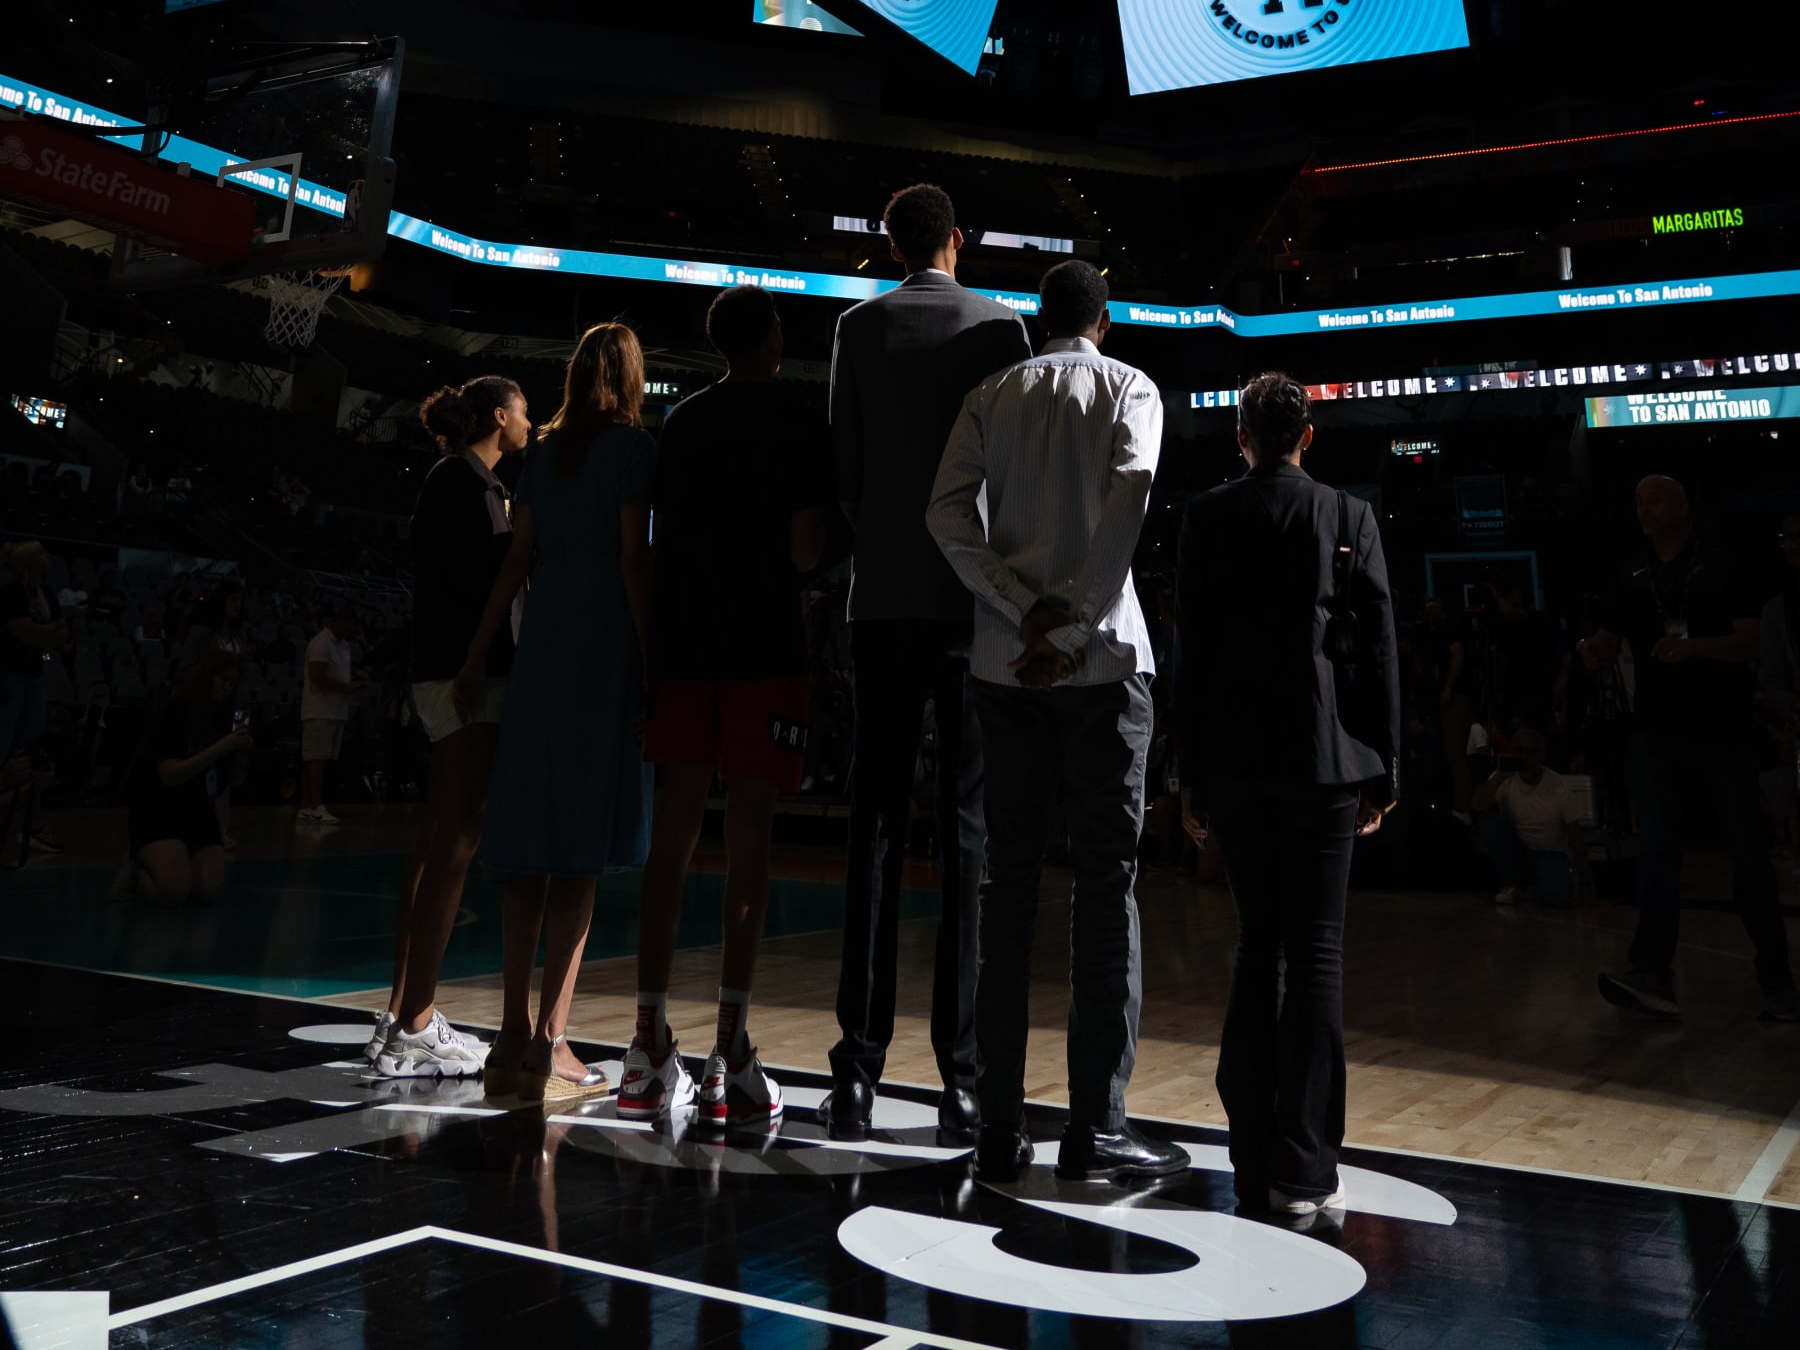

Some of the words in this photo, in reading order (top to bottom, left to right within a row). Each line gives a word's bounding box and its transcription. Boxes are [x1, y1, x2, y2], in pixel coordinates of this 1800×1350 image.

[1312, 10, 1339, 35] TO
[27, 90, 42, 111] To
[44, 98, 71, 121] San
[72, 107, 121, 127] Antoi
[312, 190, 346, 214] Antoni
[1652, 207, 1744, 234] MARGARITAS
[431, 230, 471, 255] Welcome
[472, 243, 485, 259] To
[487, 246, 510, 262] San
[512, 249, 560, 267] Antonio
[665, 264, 718, 282] Welcome
[721, 269, 734, 283] To
[736, 271, 759, 285] San
[761, 273, 806, 290] Antonio
[1558, 293, 1615, 309] Welcome
[1617, 289, 1632, 304] To
[1634, 287, 1660, 302] San
[1662, 283, 1713, 300] Antonio
[1129, 307, 1176, 324] Welcome
[1179, 311, 1191, 324] To
[1194, 307, 1214, 323] San
[1318, 314, 1369, 328] Welcome
[1370, 310, 1384, 323] To
[1386, 308, 1408, 322] San
[1410, 304, 1455, 320] Antonio
[1320, 376, 1438, 400] WELCOME
[1499, 364, 1628, 389] WELCOME
[1629, 405, 1652, 423] TO
[1656, 403, 1690, 422] SAN
[1694, 399, 1771, 421] ANTONIO
